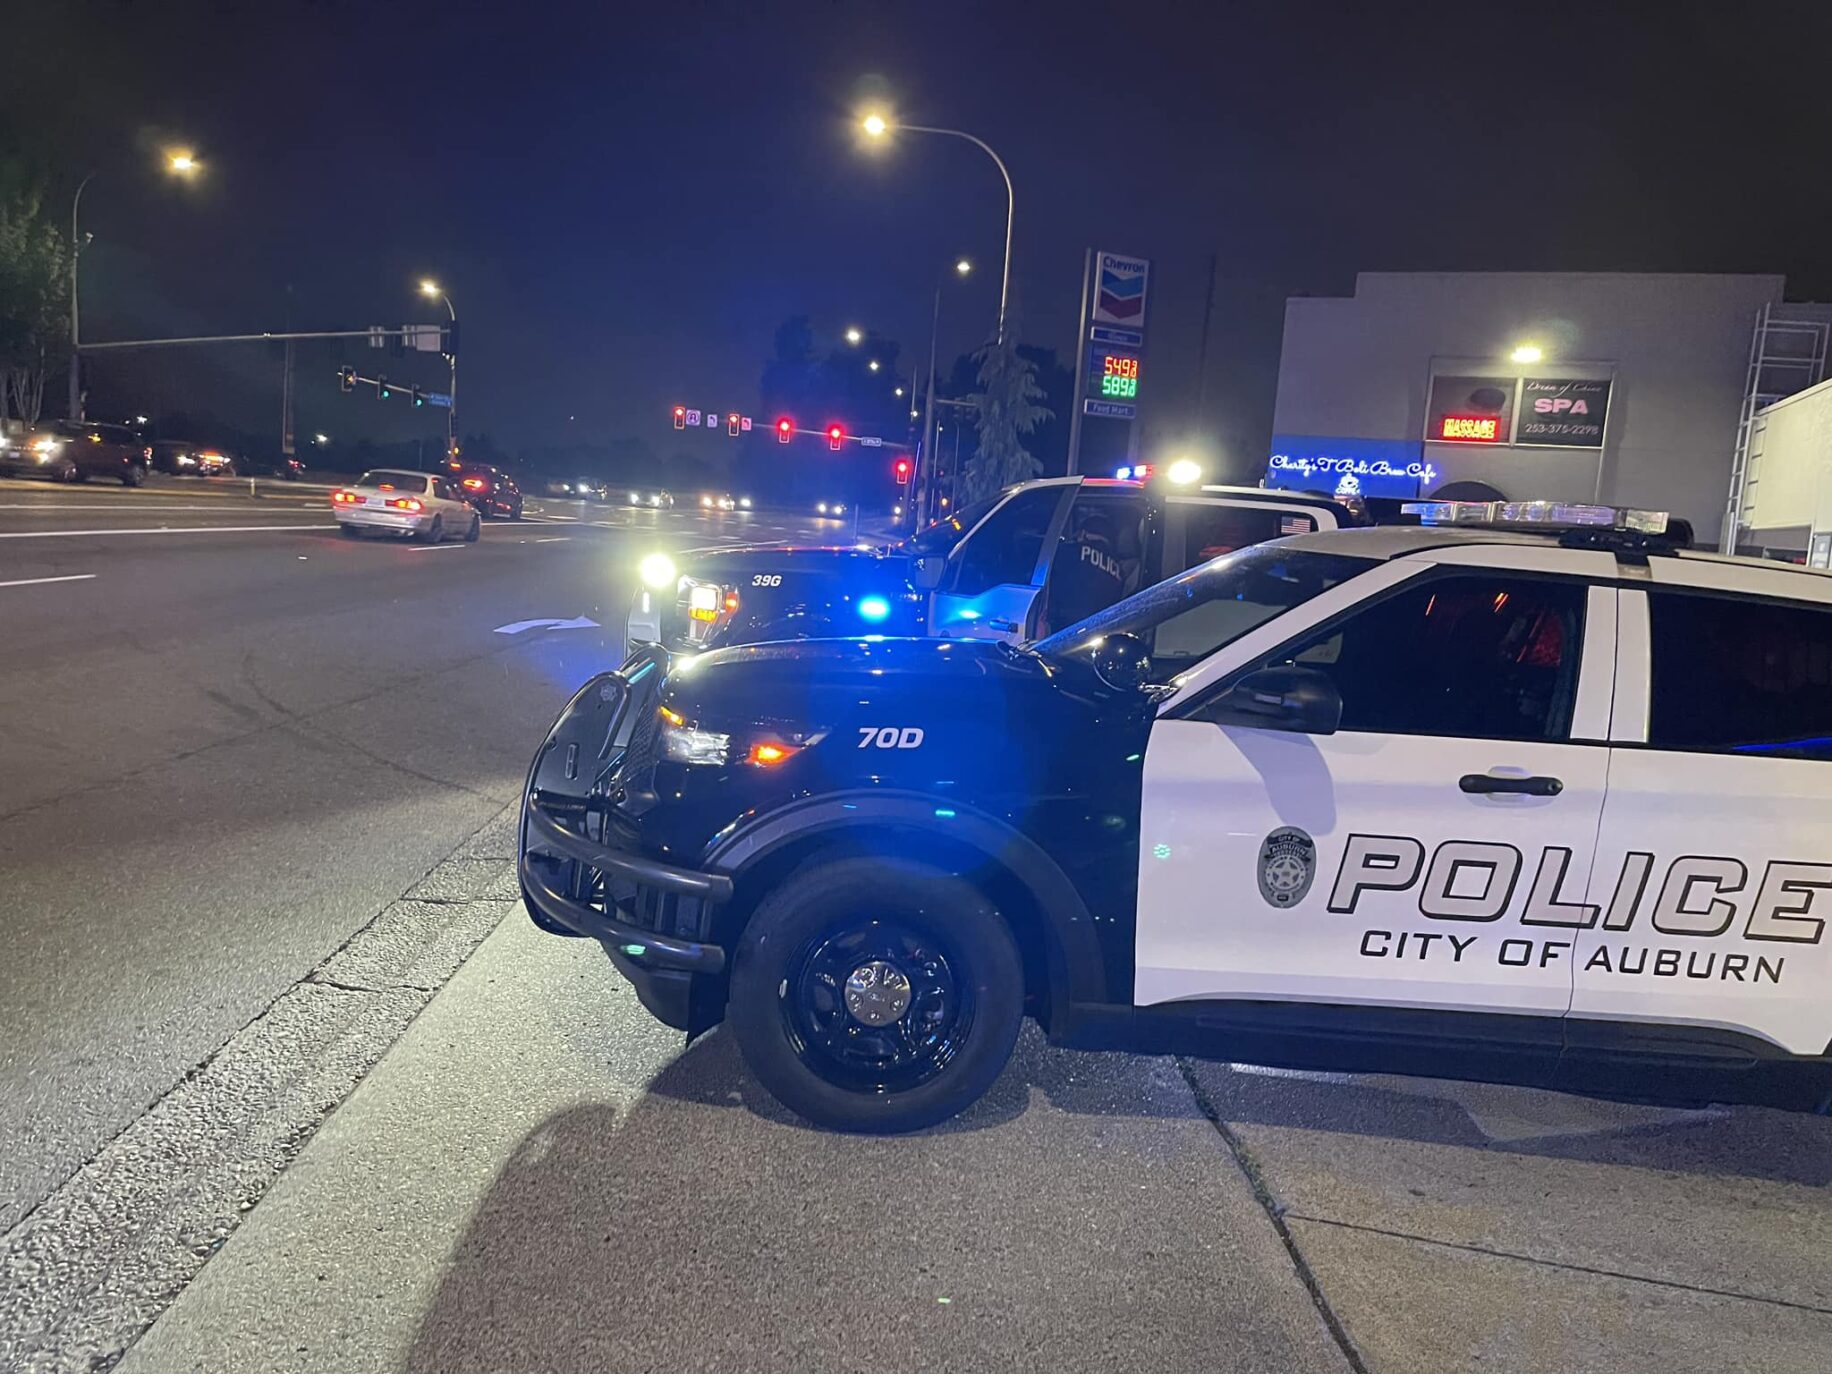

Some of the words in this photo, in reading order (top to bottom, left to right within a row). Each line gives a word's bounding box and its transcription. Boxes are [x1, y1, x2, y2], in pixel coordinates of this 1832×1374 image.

[1103, 255, 1145, 273] Chevron
[1534, 398, 1588, 415] SPA
[1443, 418, 1496, 438] MASSAGE
[751, 574, 782, 587] 39G
[858, 727, 924, 749] 70D
[1326, 833, 1832, 945] POLICE
[1360, 930, 1478, 962] CITY
[1498, 939, 1571, 968] OF
[1584, 945, 1785, 984] AUBURN
